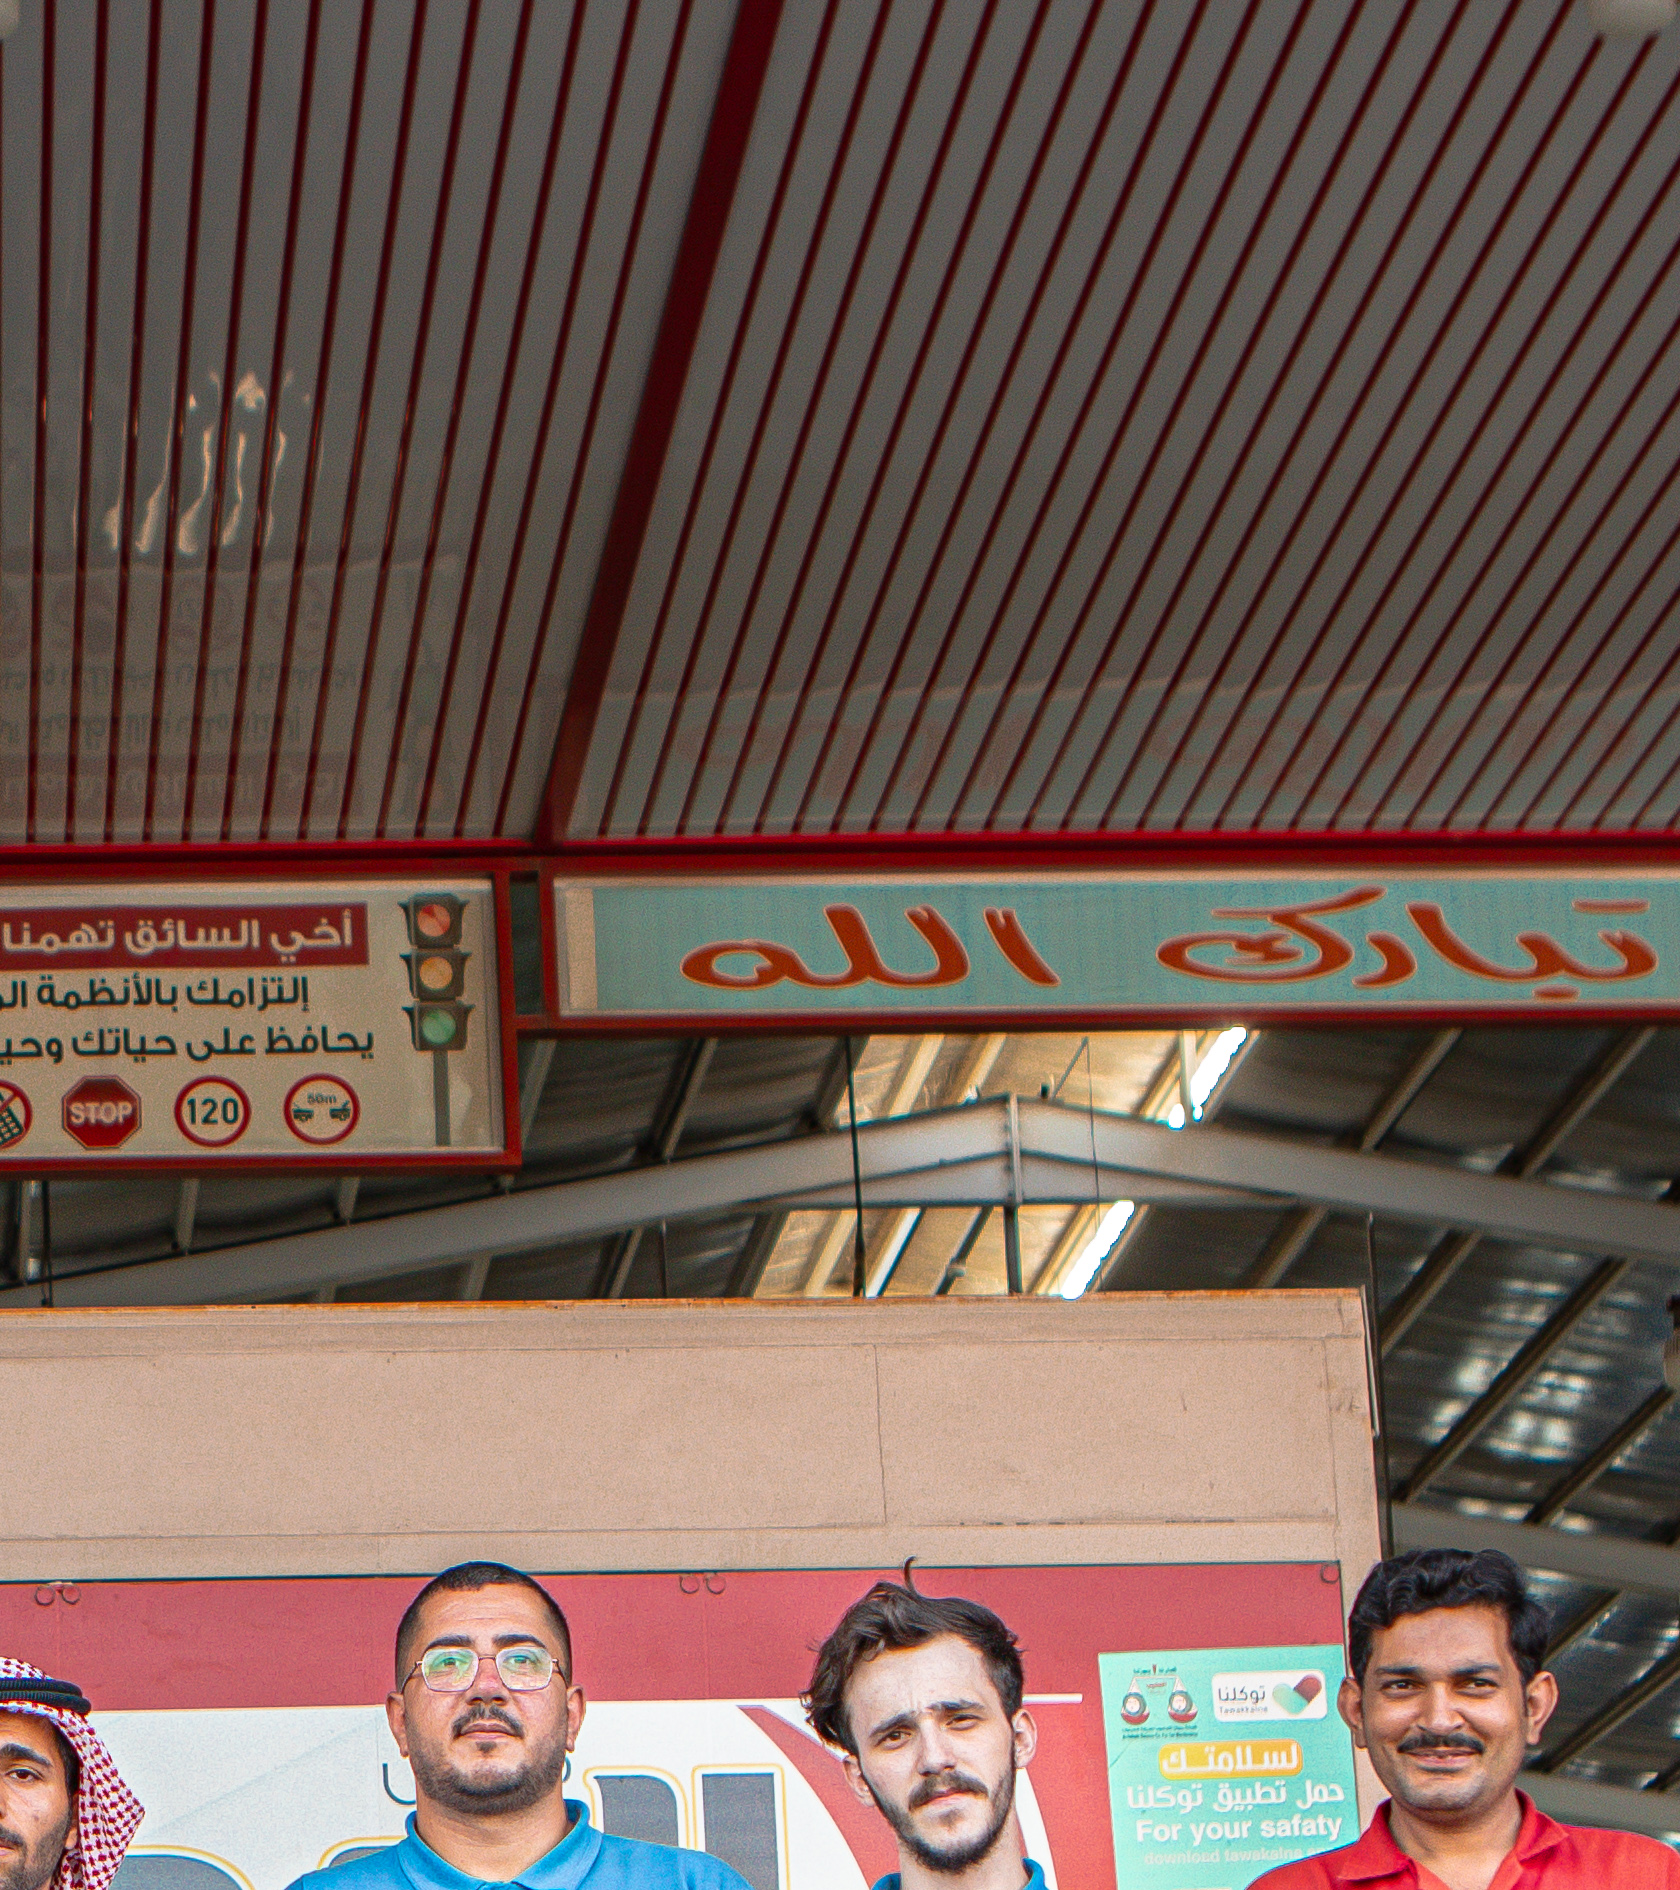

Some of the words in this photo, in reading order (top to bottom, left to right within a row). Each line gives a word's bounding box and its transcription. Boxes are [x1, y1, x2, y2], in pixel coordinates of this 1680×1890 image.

[2, 920, 116, 954] تهمنا
[124, 918, 260, 955] السائق
[269, 908, 353, 964] أخي
[679, 904, 1061, 988] الله
[1155, 885, 1660, 1000] تبارك
[37, 972, 179, 1010] بالأنظمة
[71, 1028, 178, 1064] حياتك
[184, 1028, 257, 1061] على
[264, 1026, 375, 1060] يحافظ
[69, 1101, 134, 1127] STOP
[186, 1097, 239, 1126] 120
[1217, 1685, 1267, 1705] توكلنا
[1161, 1742, 1299, 1775] لسلامتك
[1127, 1782, 1204, 1815] توكلنا
[1213, 1780, 1288, 1813] تطبيق
[1296, 1779, 1346, 1810] حمل
[1135, 1819, 1183, 1843] For
[1189, 1820, 1253, 1847] your
[1260, 1813, 1343, 1842] safaty
[1144, 1849, 1221, 1866] download
